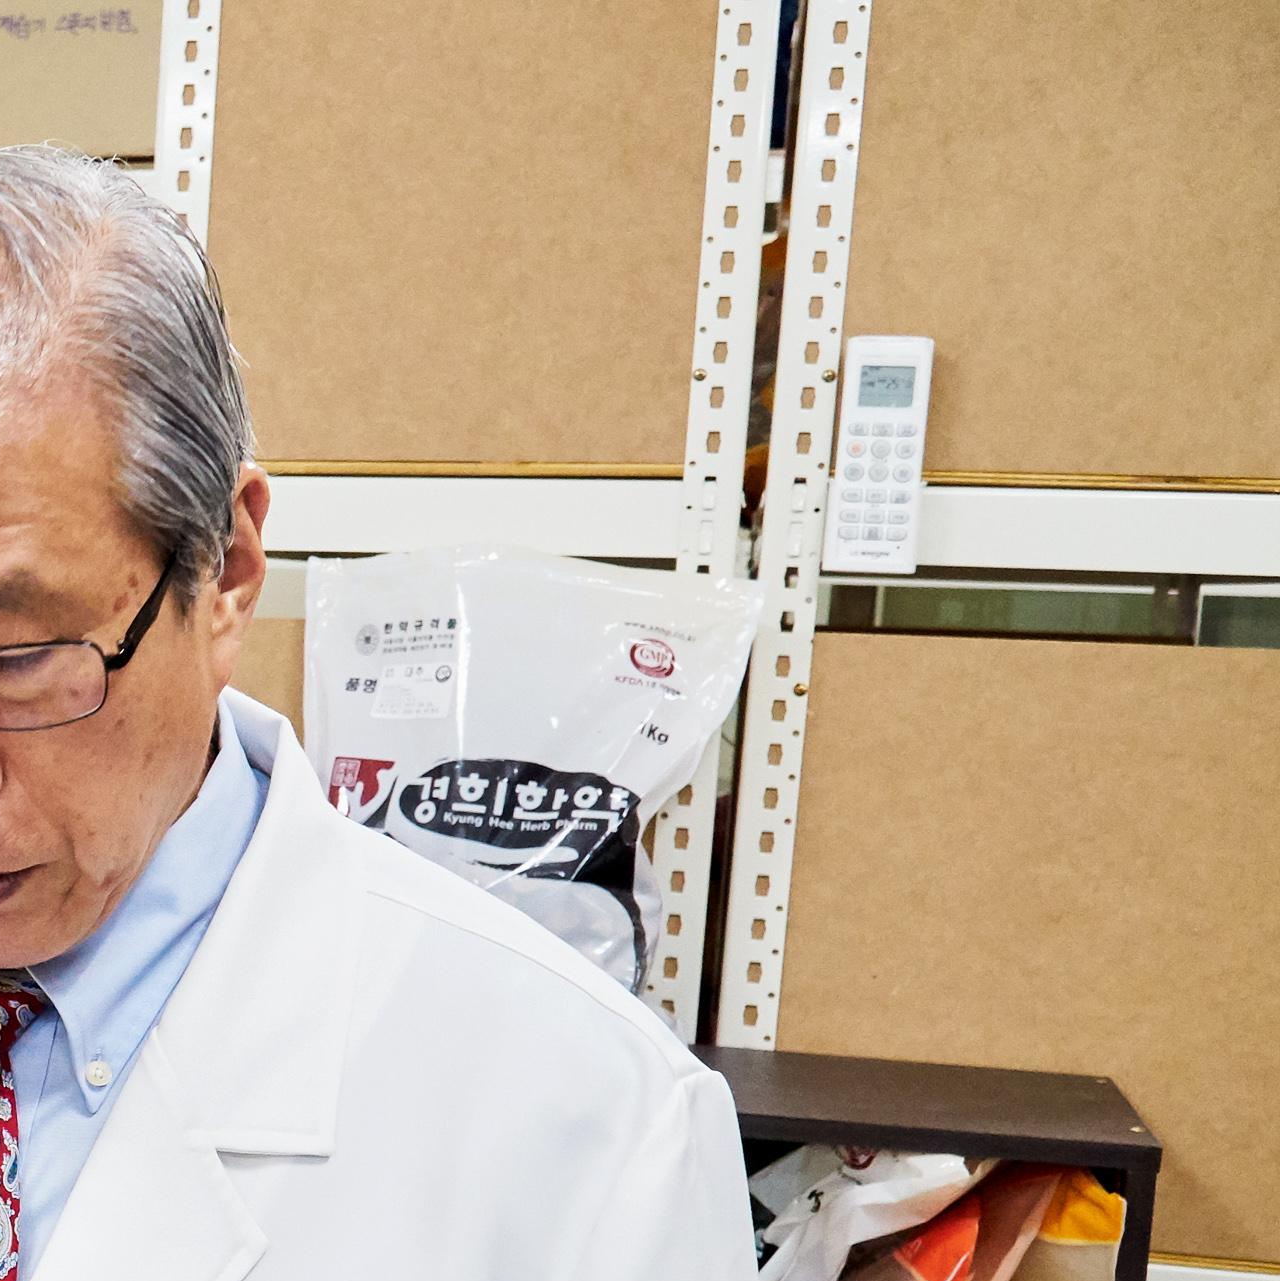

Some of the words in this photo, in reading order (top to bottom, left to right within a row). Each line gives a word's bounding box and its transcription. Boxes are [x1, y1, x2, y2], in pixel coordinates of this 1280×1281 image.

[639, 648, 668, 664] GMP
[615, 675, 643, 687] KFDA
[408, 772, 630, 833] 경희한약
[443, 811, 483, 828] Kyung
[489, 817, 514, 830] Hee
[520, 820, 550, 832] Herb
